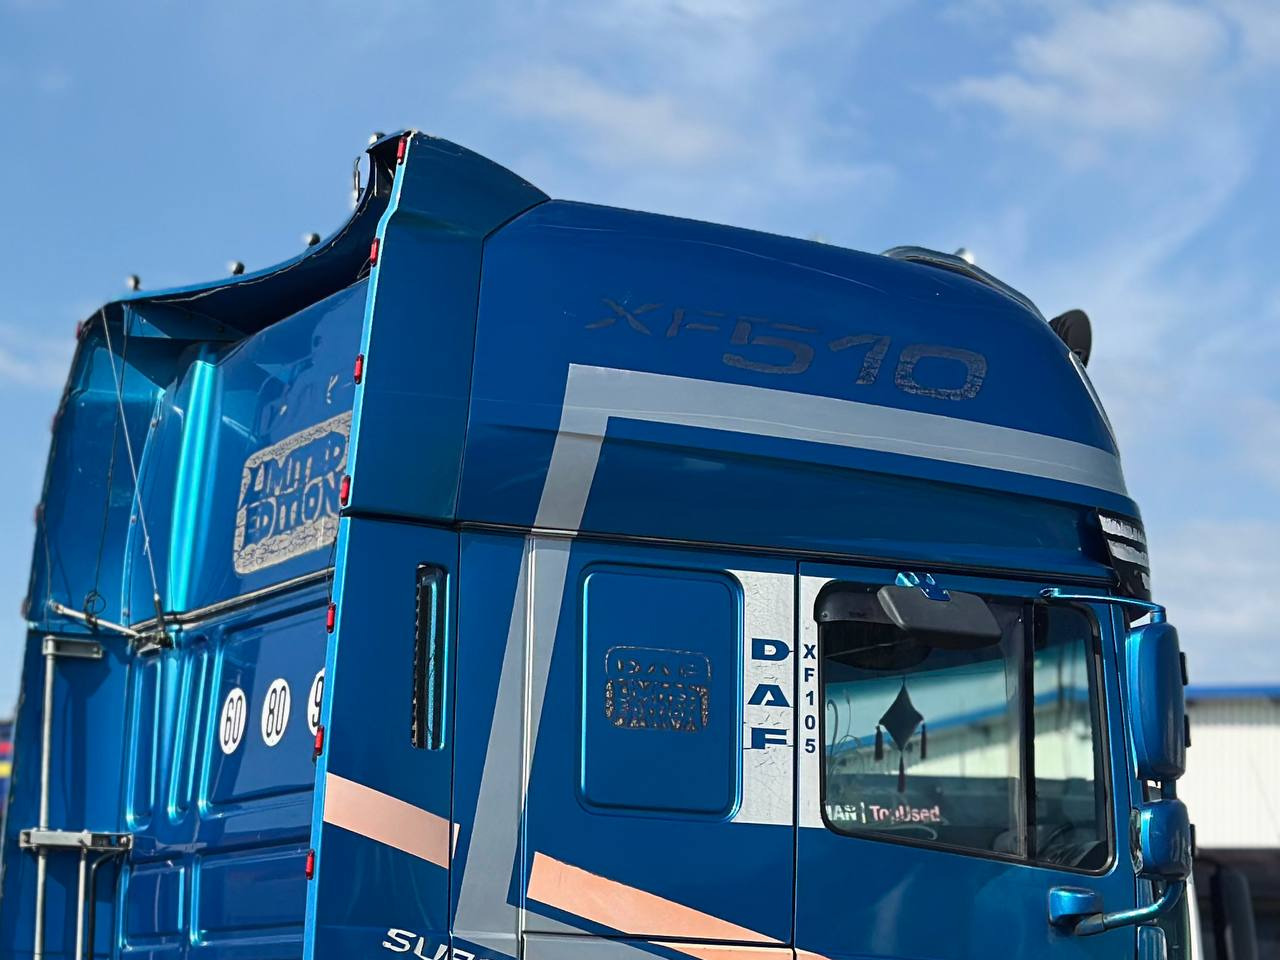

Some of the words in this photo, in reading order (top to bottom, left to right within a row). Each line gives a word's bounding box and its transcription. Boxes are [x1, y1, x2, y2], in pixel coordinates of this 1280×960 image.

[585, 299, 988, 400] XF510
[266, 686, 287, 738] 80
[312, 676, 324, 728] 9
[748, 638, 790, 750] DAF
[224, 695, 242, 746] 60
